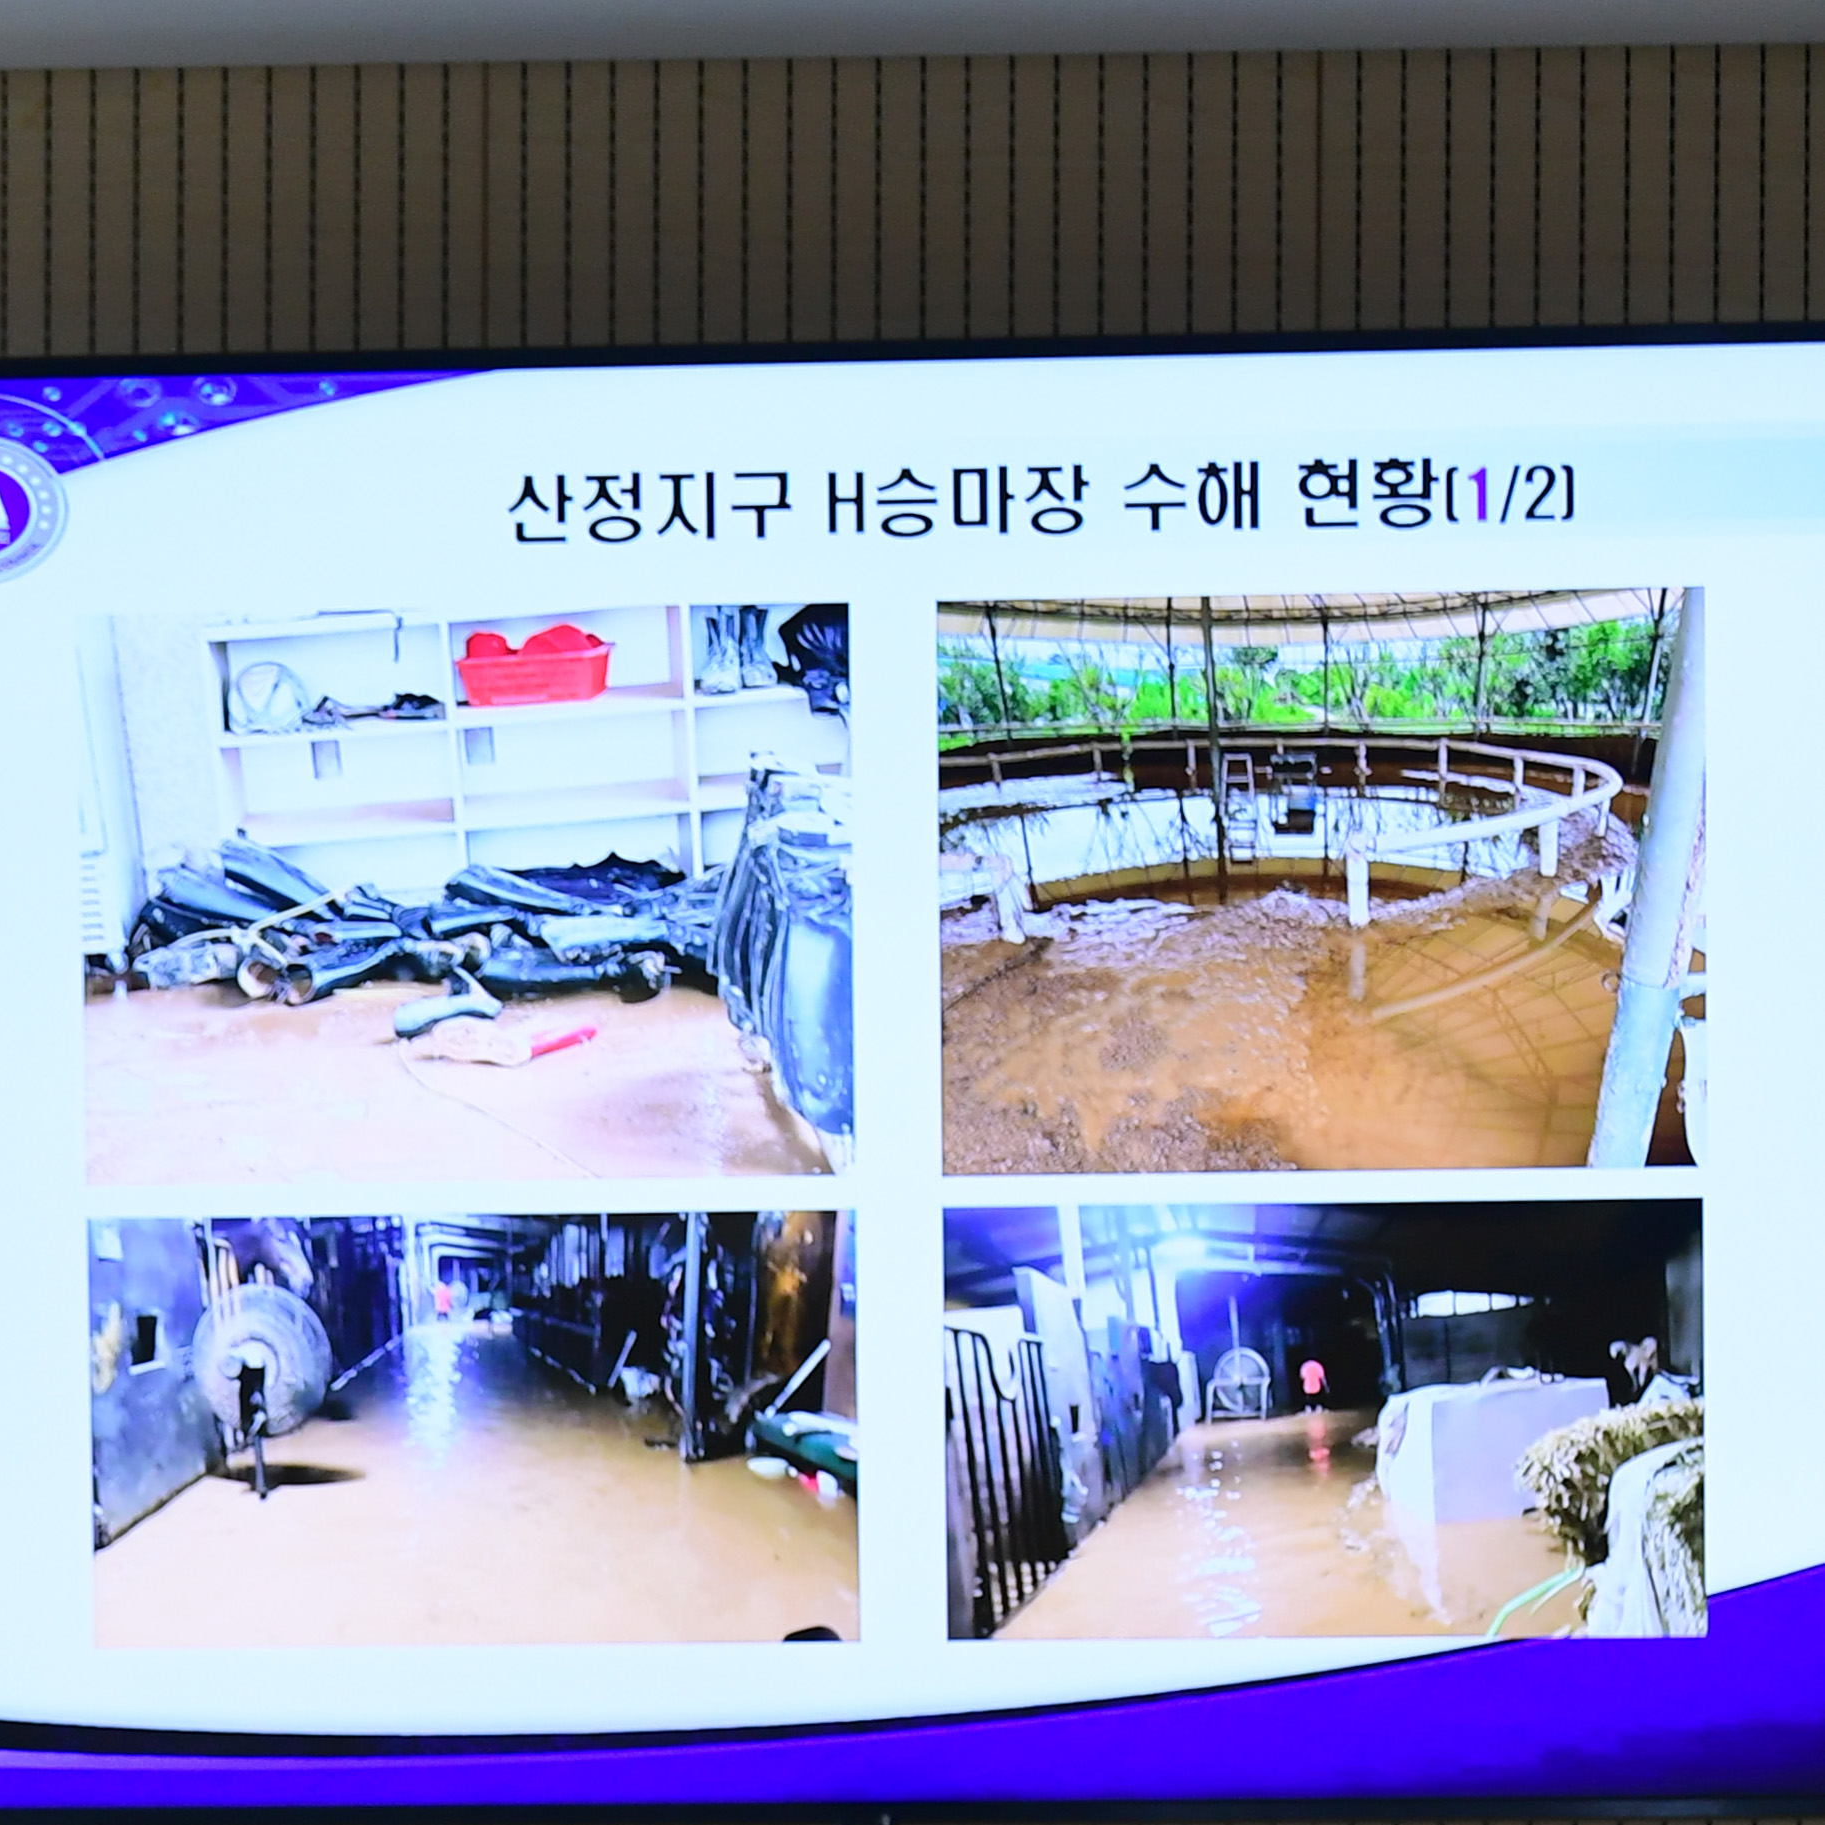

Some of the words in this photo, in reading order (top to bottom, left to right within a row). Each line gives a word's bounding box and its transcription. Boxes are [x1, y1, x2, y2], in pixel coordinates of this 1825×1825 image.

[508, 471, 792, 543] 산정지구
[827, 464, 1090, 538] H승마장
[1124, 462, 1259, 531] 수해
